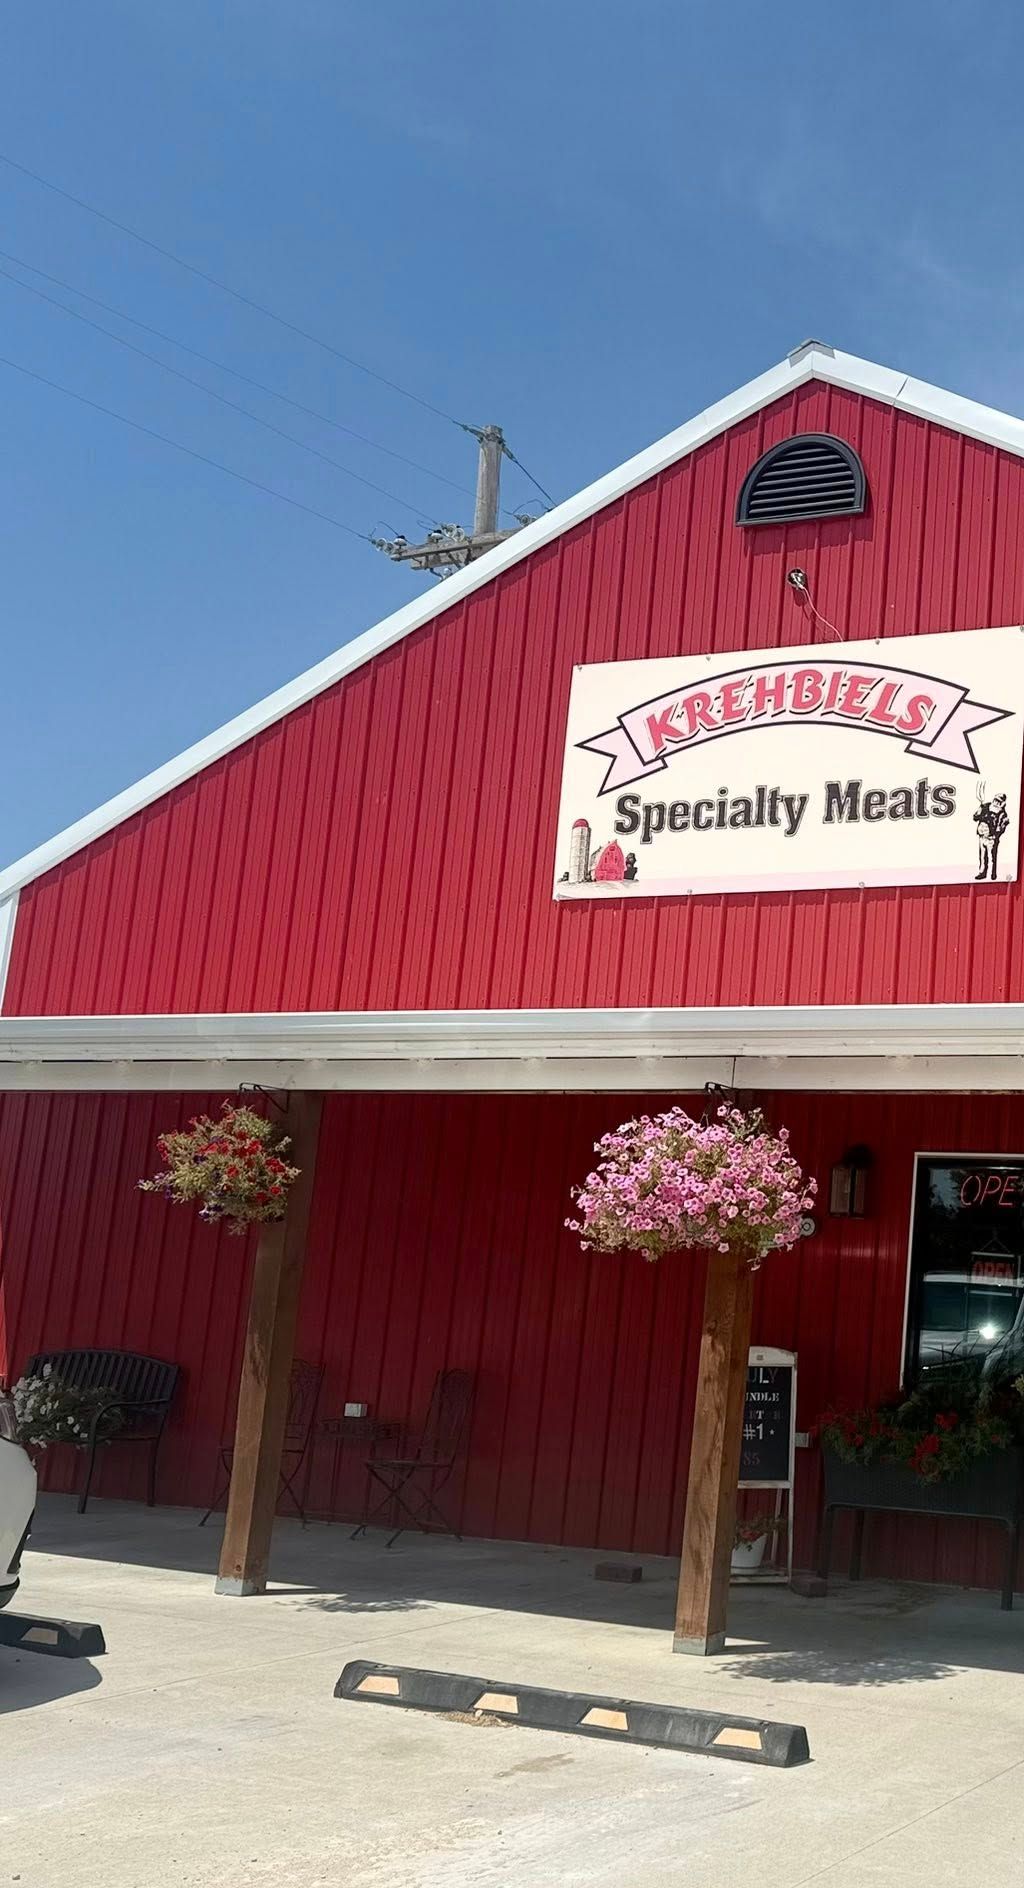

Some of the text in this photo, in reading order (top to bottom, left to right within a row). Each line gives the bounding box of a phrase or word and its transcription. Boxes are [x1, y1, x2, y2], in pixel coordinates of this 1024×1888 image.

[644, 668, 937, 758] KREHBIELS
[613, 777, 957, 844] Specialty Meats
[971, 1258, 1015, 1278] OPEN
[743, 1423, 764, 1440] #1
